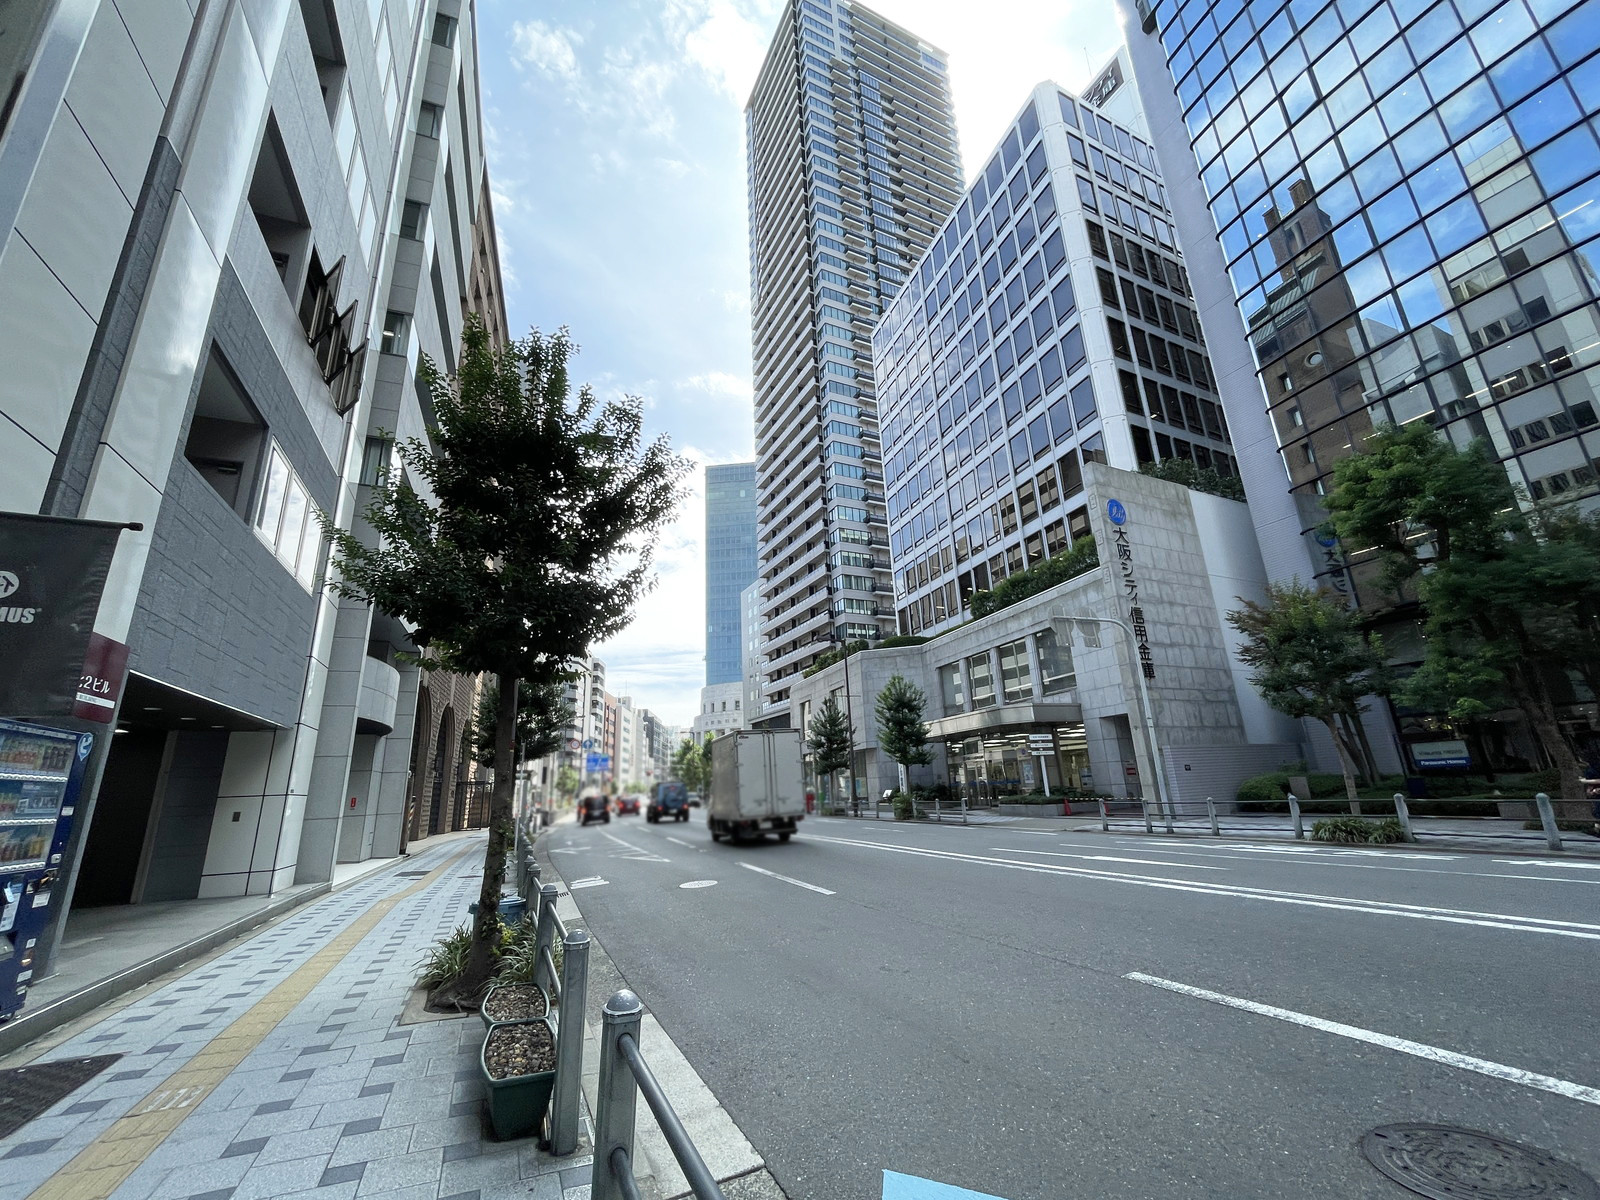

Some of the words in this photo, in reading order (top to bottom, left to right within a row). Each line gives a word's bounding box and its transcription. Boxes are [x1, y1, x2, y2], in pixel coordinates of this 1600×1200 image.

[1112, 527, 1156, 680] 大阪シティ信用金庫
